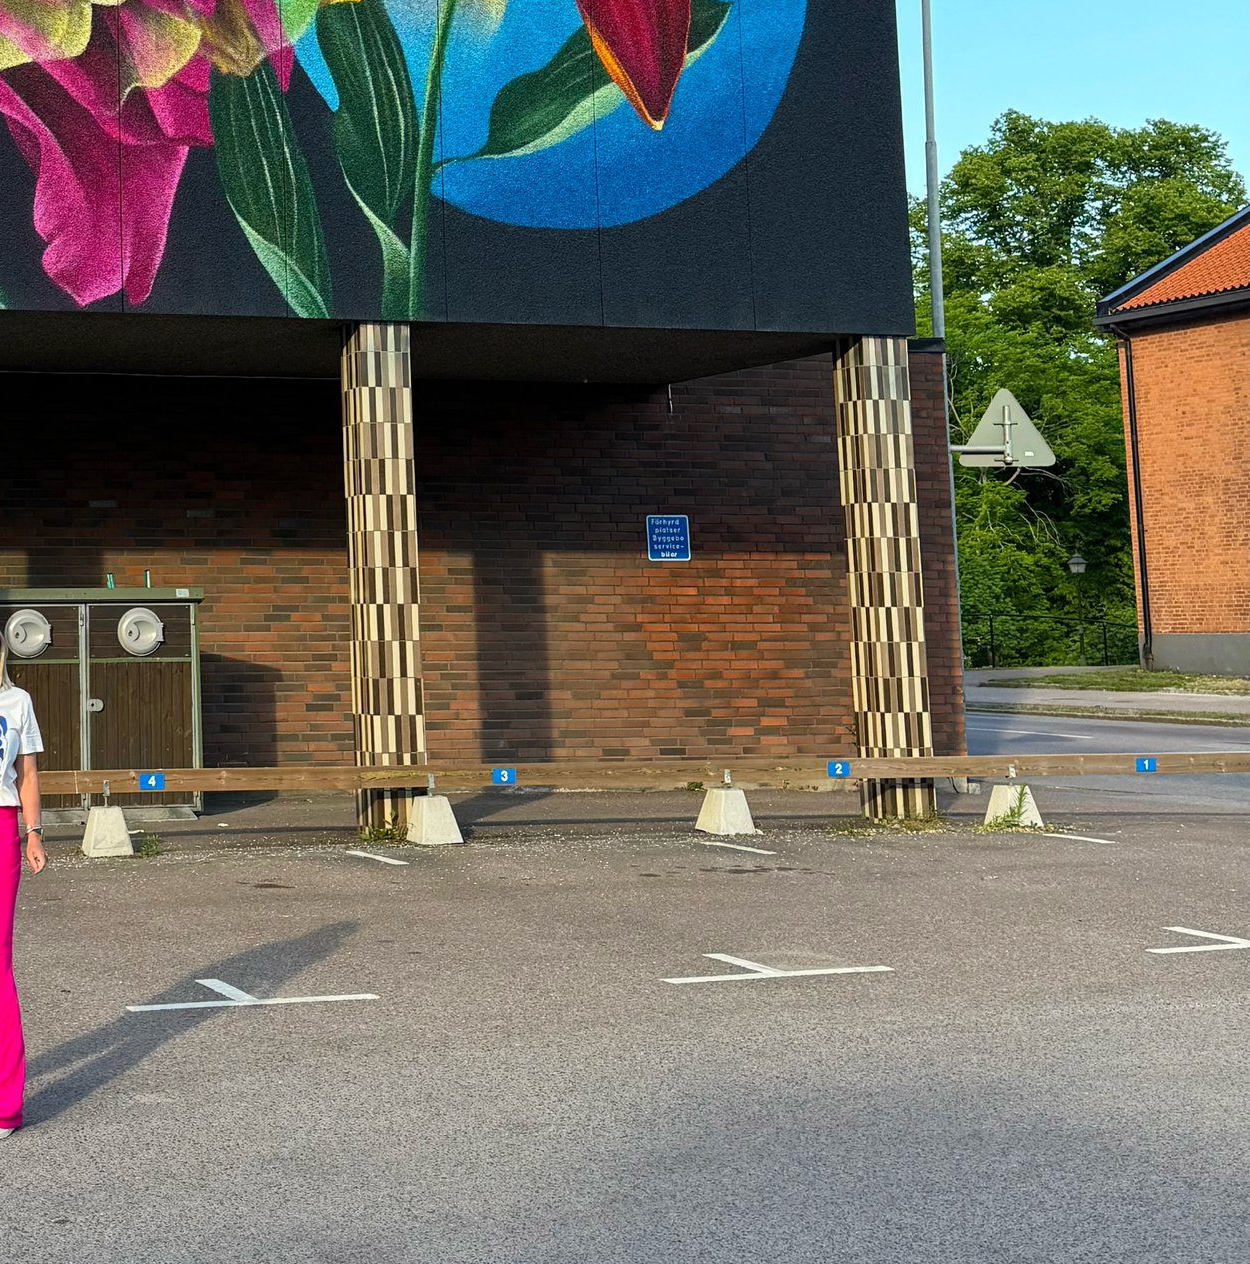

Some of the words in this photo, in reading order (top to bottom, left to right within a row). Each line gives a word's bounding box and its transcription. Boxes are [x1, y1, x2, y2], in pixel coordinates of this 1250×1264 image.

[654, 526, 681, 534] platser
[652, 534, 685, 543] Byggebo
[834, 763, 843, 775] 2
[1143, 759, 1149, 770] 1
[147, 775, 156, 787] 4
[500, 770, 509, 782] 3
